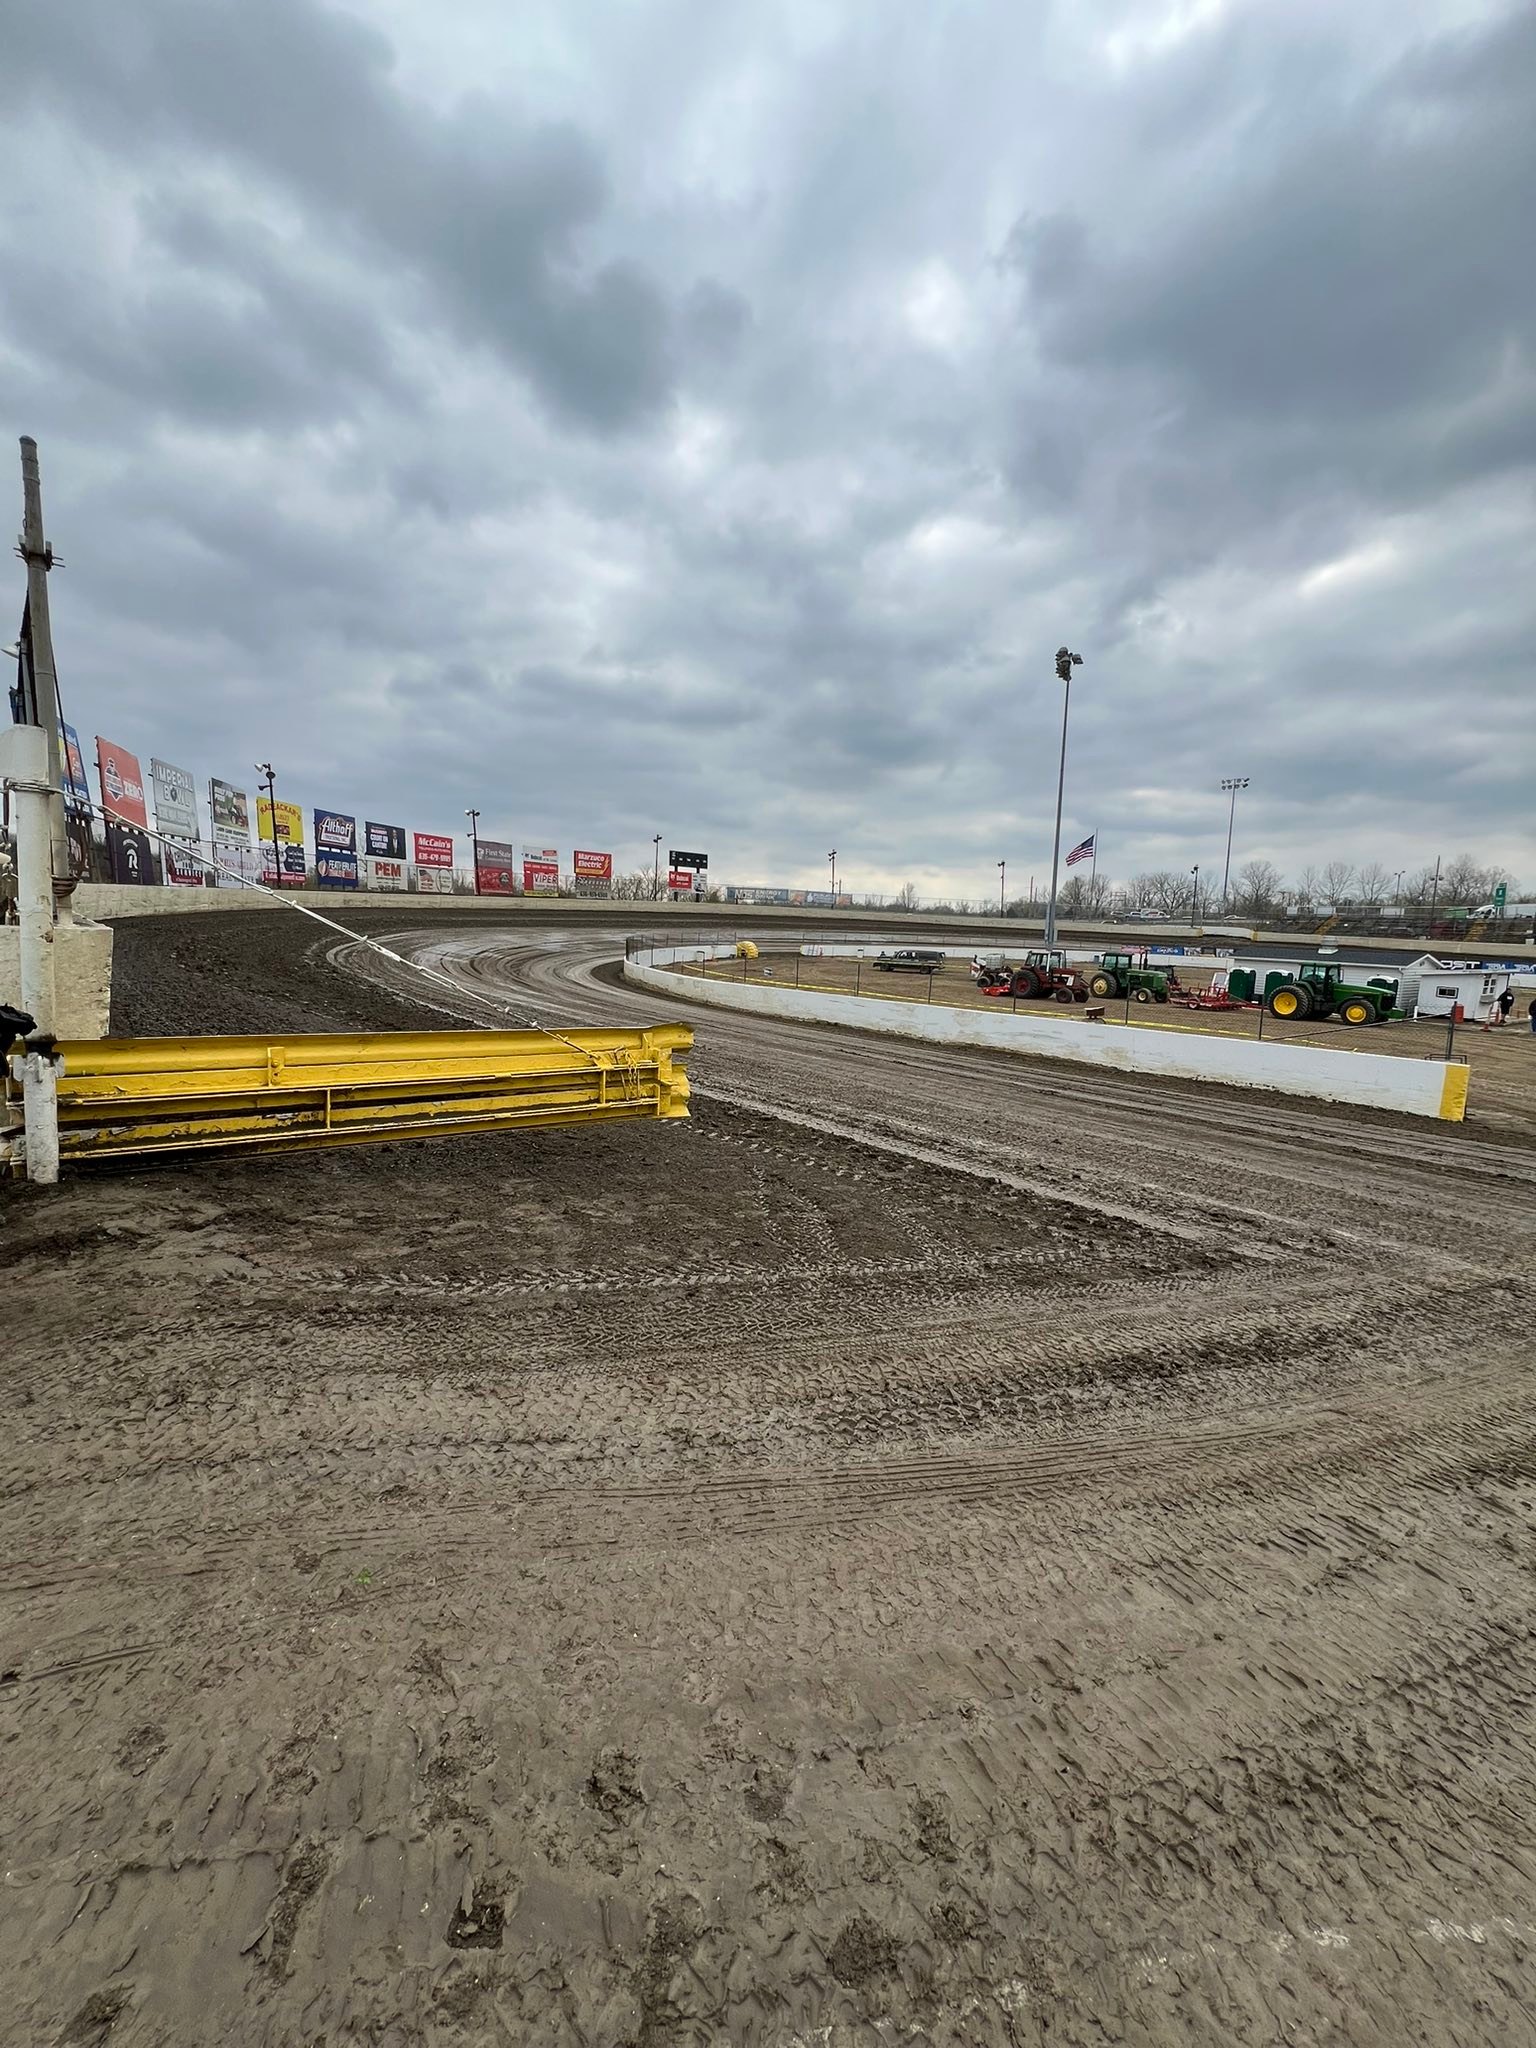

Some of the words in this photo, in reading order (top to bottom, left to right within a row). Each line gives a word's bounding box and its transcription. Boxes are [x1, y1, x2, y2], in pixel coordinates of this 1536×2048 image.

[156, 765, 193, 792] IMPERIAL
[163, 784, 190, 807] BOWL
[321, 818, 353, 835] Althoff
[418, 837, 451, 848] McCain's
[485, 848, 498, 856] First
[498, 849, 512, 858] State
[578, 853, 605, 862] Marzuco
[375, 861, 401, 877] PEM
[578, 861, 603, 869] Electric
[534, 873, 558, 883] VIPER
